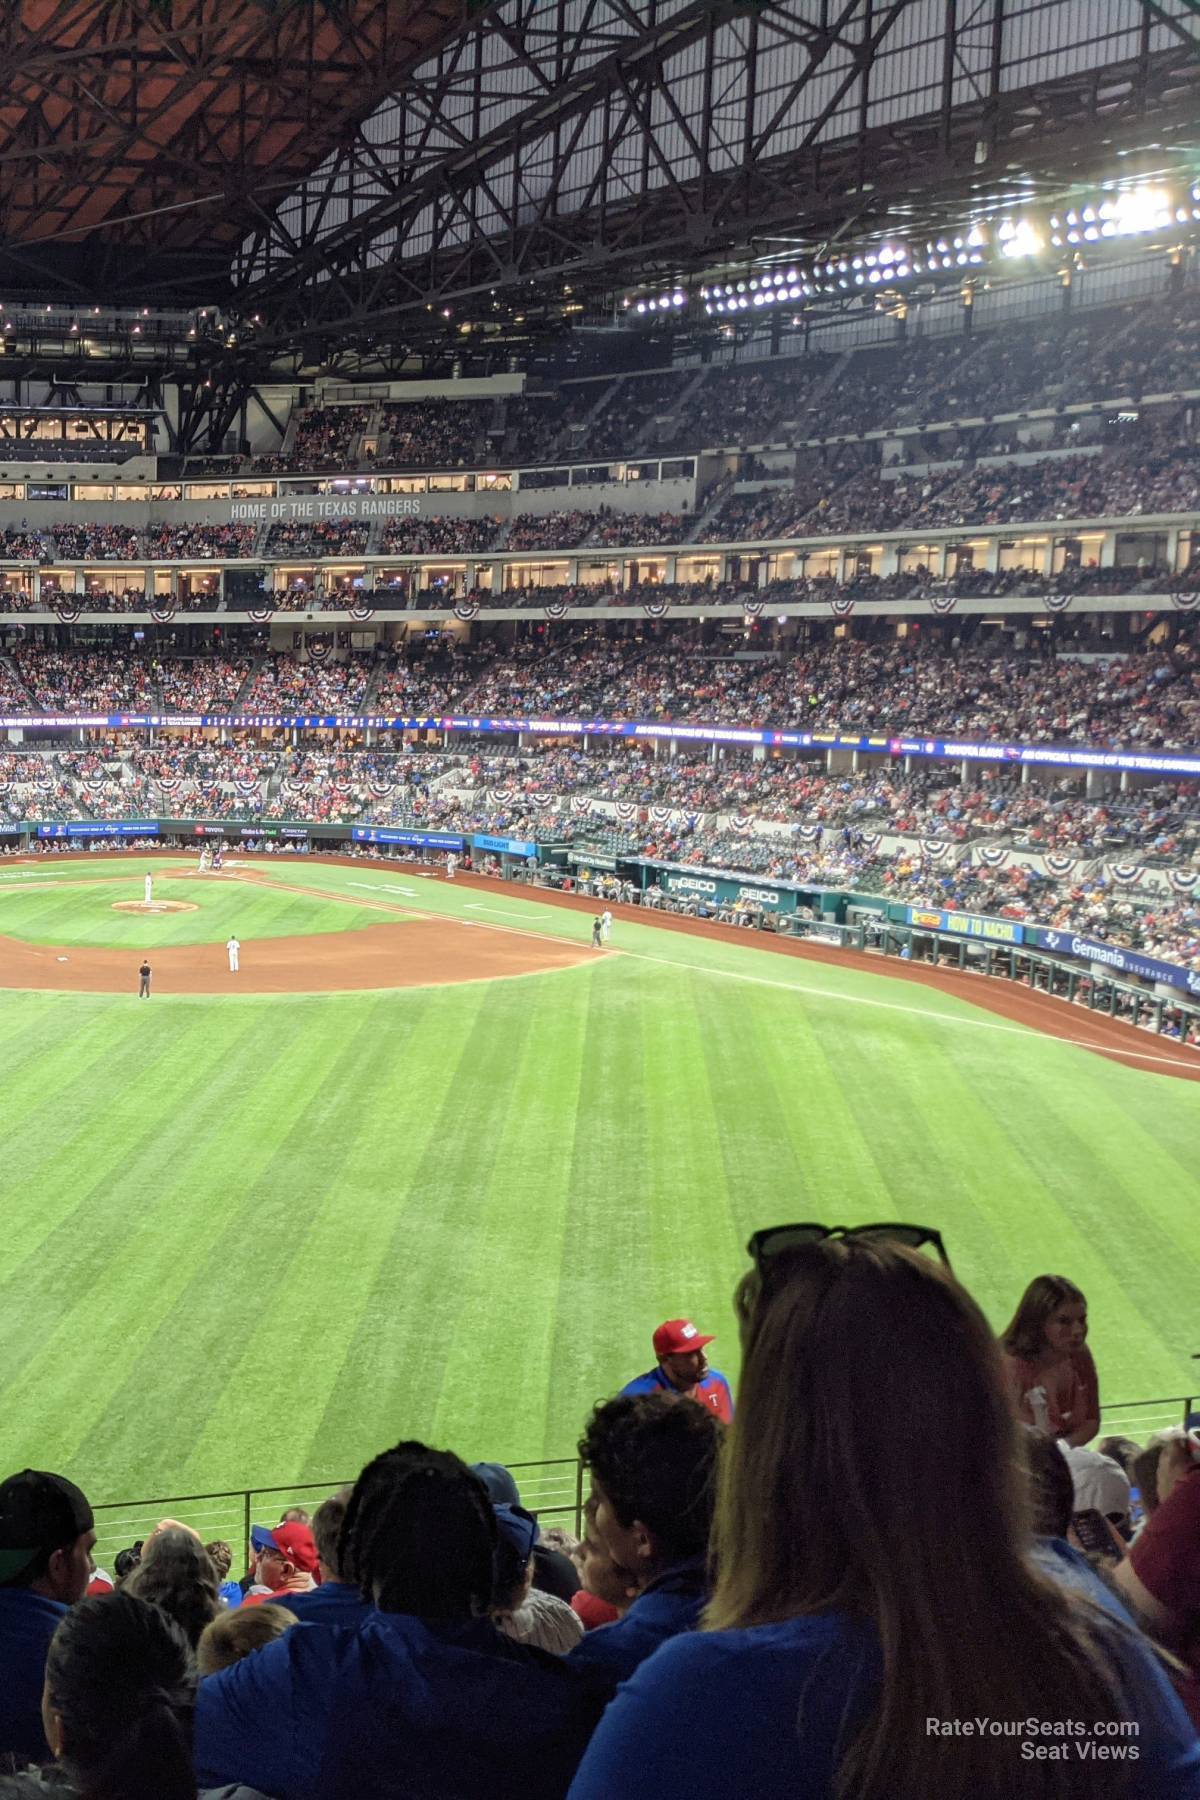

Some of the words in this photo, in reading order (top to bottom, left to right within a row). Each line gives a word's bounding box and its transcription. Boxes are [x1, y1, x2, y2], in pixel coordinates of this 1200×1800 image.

[231, 504, 267, 518] HOME
[271, 503, 287, 517] OF
[290, 502, 313, 517] THE
[317, 501, 357, 516] TEXAS
[361, 500, 420, 515] RANGERS
[0, 824, 17, 833] Mitel
[494, 840, 509, 849] LIGHT
[679, 877, 716, 893] GEICO
[739, 887, 779, 903] GEICO
[1071, 938, 1125, 967] Germania
[709, 1393, 718, 1407] T
